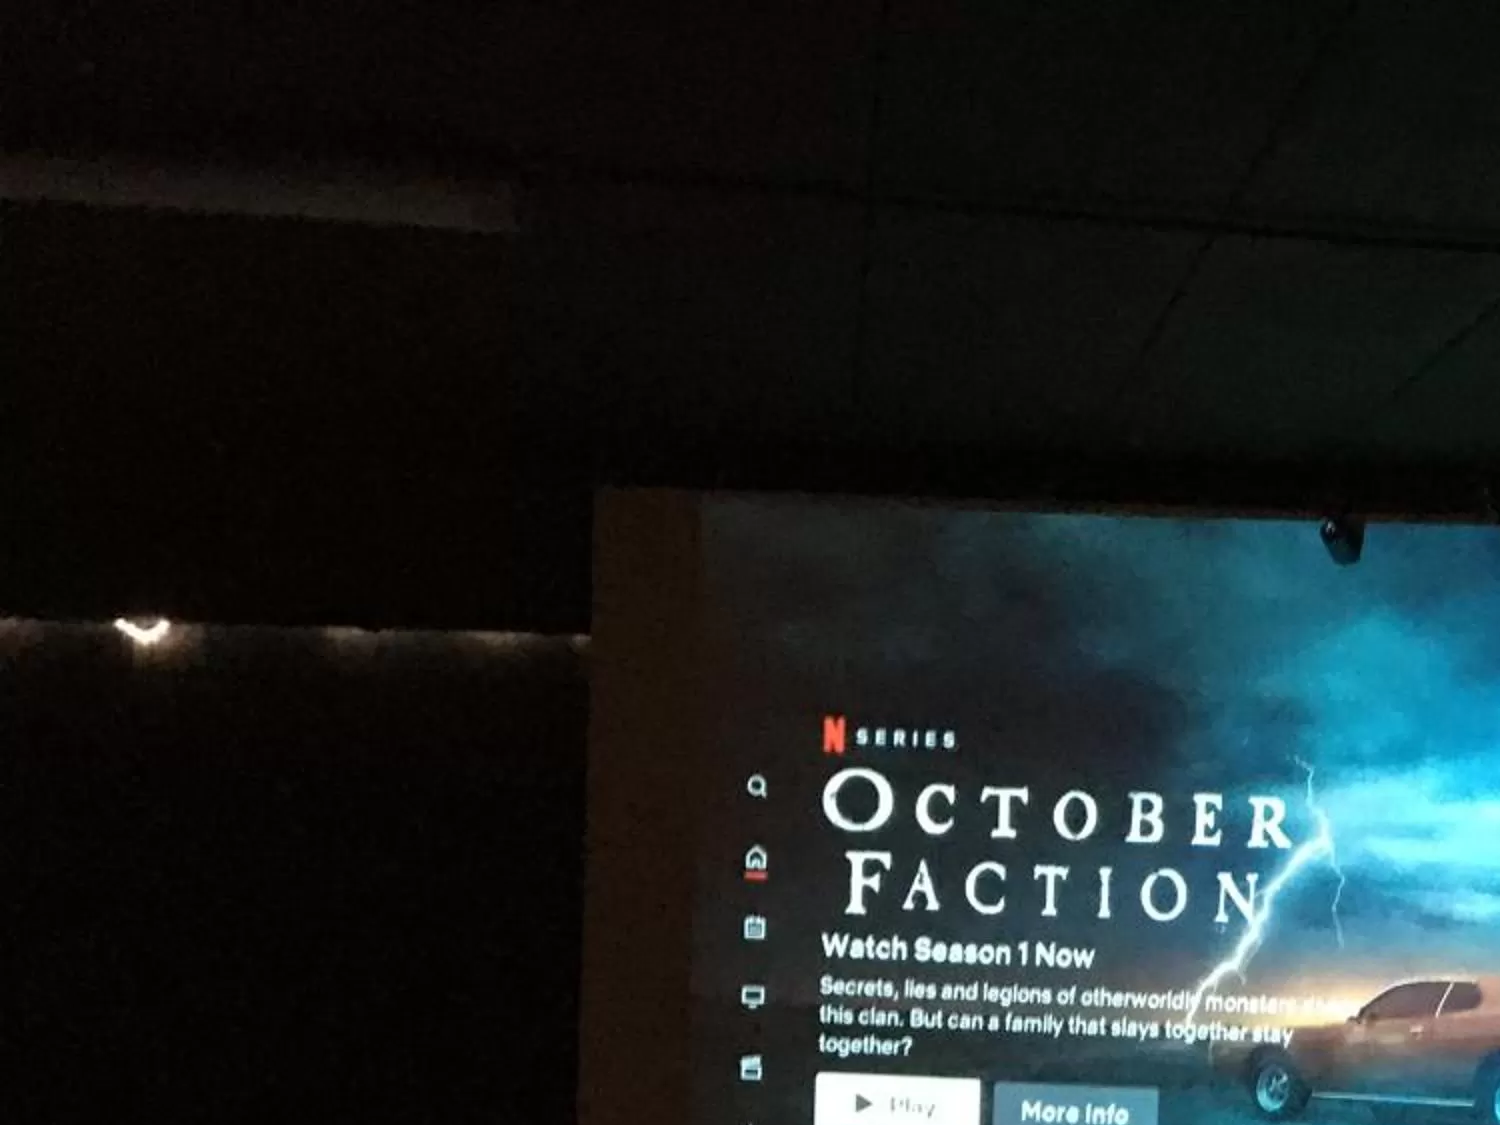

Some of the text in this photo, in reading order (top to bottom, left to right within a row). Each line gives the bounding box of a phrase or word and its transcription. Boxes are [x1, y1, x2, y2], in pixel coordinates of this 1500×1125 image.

[823, 716, 956, 752] N SERIES
[822, 767, 1292, 849] OCTOBER
[844, 850, 1261, 925] FACTION
[821, 932, 1095, 969] Watch Season 1 Now
[820, 974, 899, 1001] Secrets,
[904, 978, 936, 1000] lies
[941, 981, 979, 1001] and
[983, 983, 1051, 1006] legions
[1056, 984, 1077, 1007] of
[819, 1003, 1294, 1049] this clan. But can a family that slays together stay
[819, 1034, 913, 1057] together?
[1021, 1099, 1079, 1124] More
